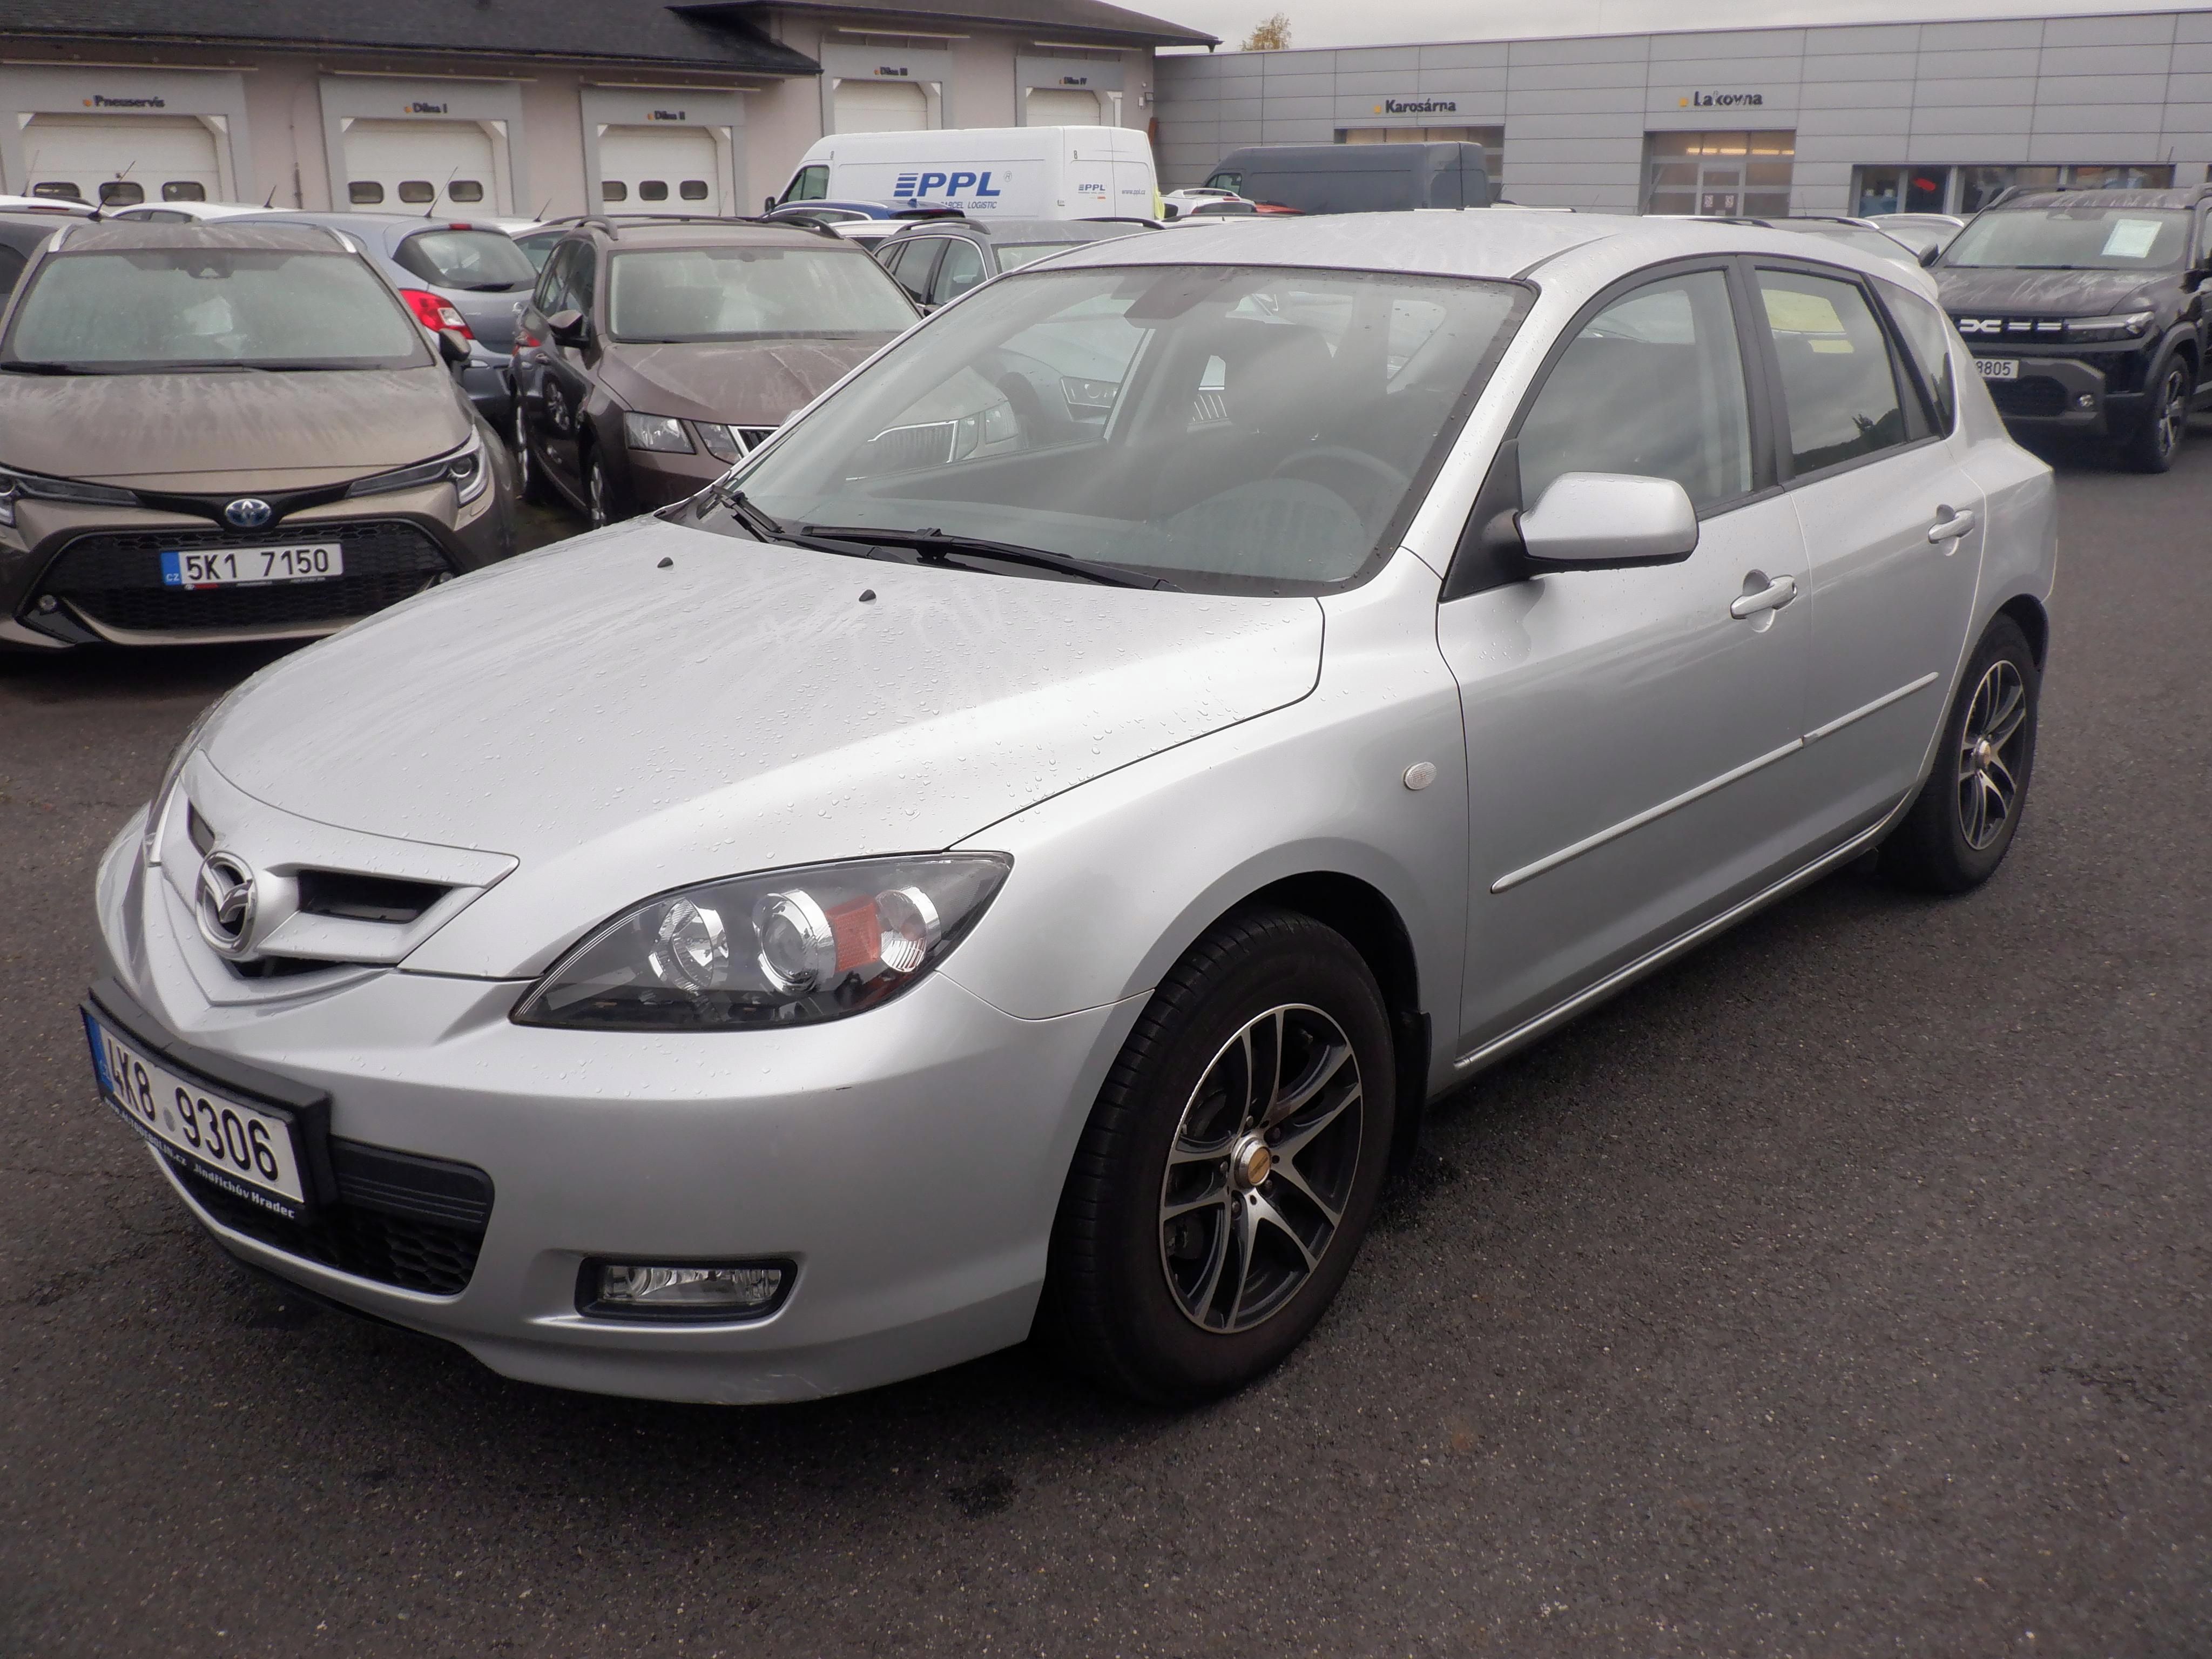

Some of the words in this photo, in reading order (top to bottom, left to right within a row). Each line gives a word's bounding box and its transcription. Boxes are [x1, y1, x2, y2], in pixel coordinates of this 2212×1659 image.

[93, 95, 165, 107] Pneuservis
[1385, 98, 1456, 113] Karosárna
[1694, 90, 1763, 106] Lakovna
[916, 172, 1001, 197] PPL
[186, 553, 237, 580] 5K1
[261, 549, 328, 577] 7150
[166, 573, 180, 582] CZ
[108, 1038, 156, 1121] 4K8
[175, 1087, 278, 1181] 9306
[251, 1192, 295, 1219] Hradec
